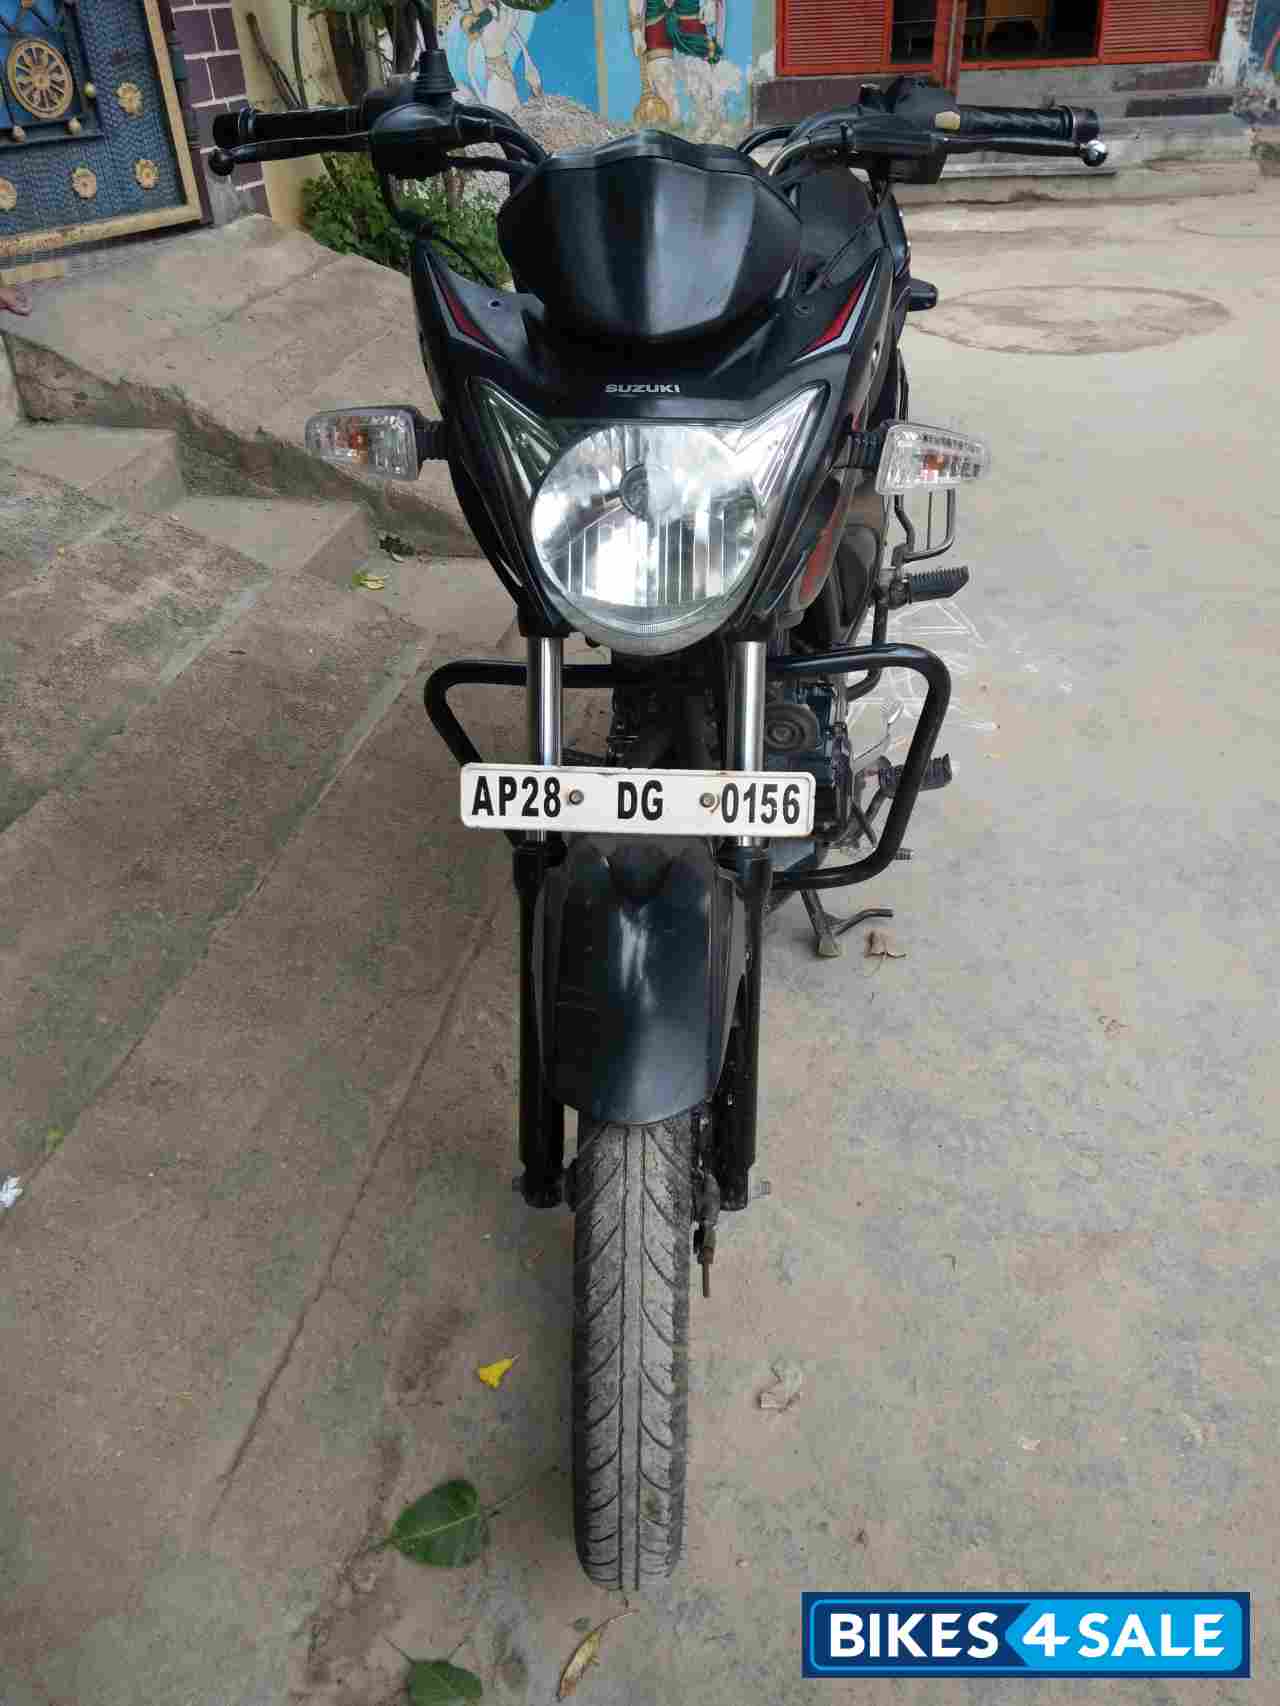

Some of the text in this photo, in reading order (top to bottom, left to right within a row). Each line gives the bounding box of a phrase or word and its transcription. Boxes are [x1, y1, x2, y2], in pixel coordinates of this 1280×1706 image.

[605, 384, 681, 393] SUZUKI
[472, 775, 801, 825] AP28 DG 0156
